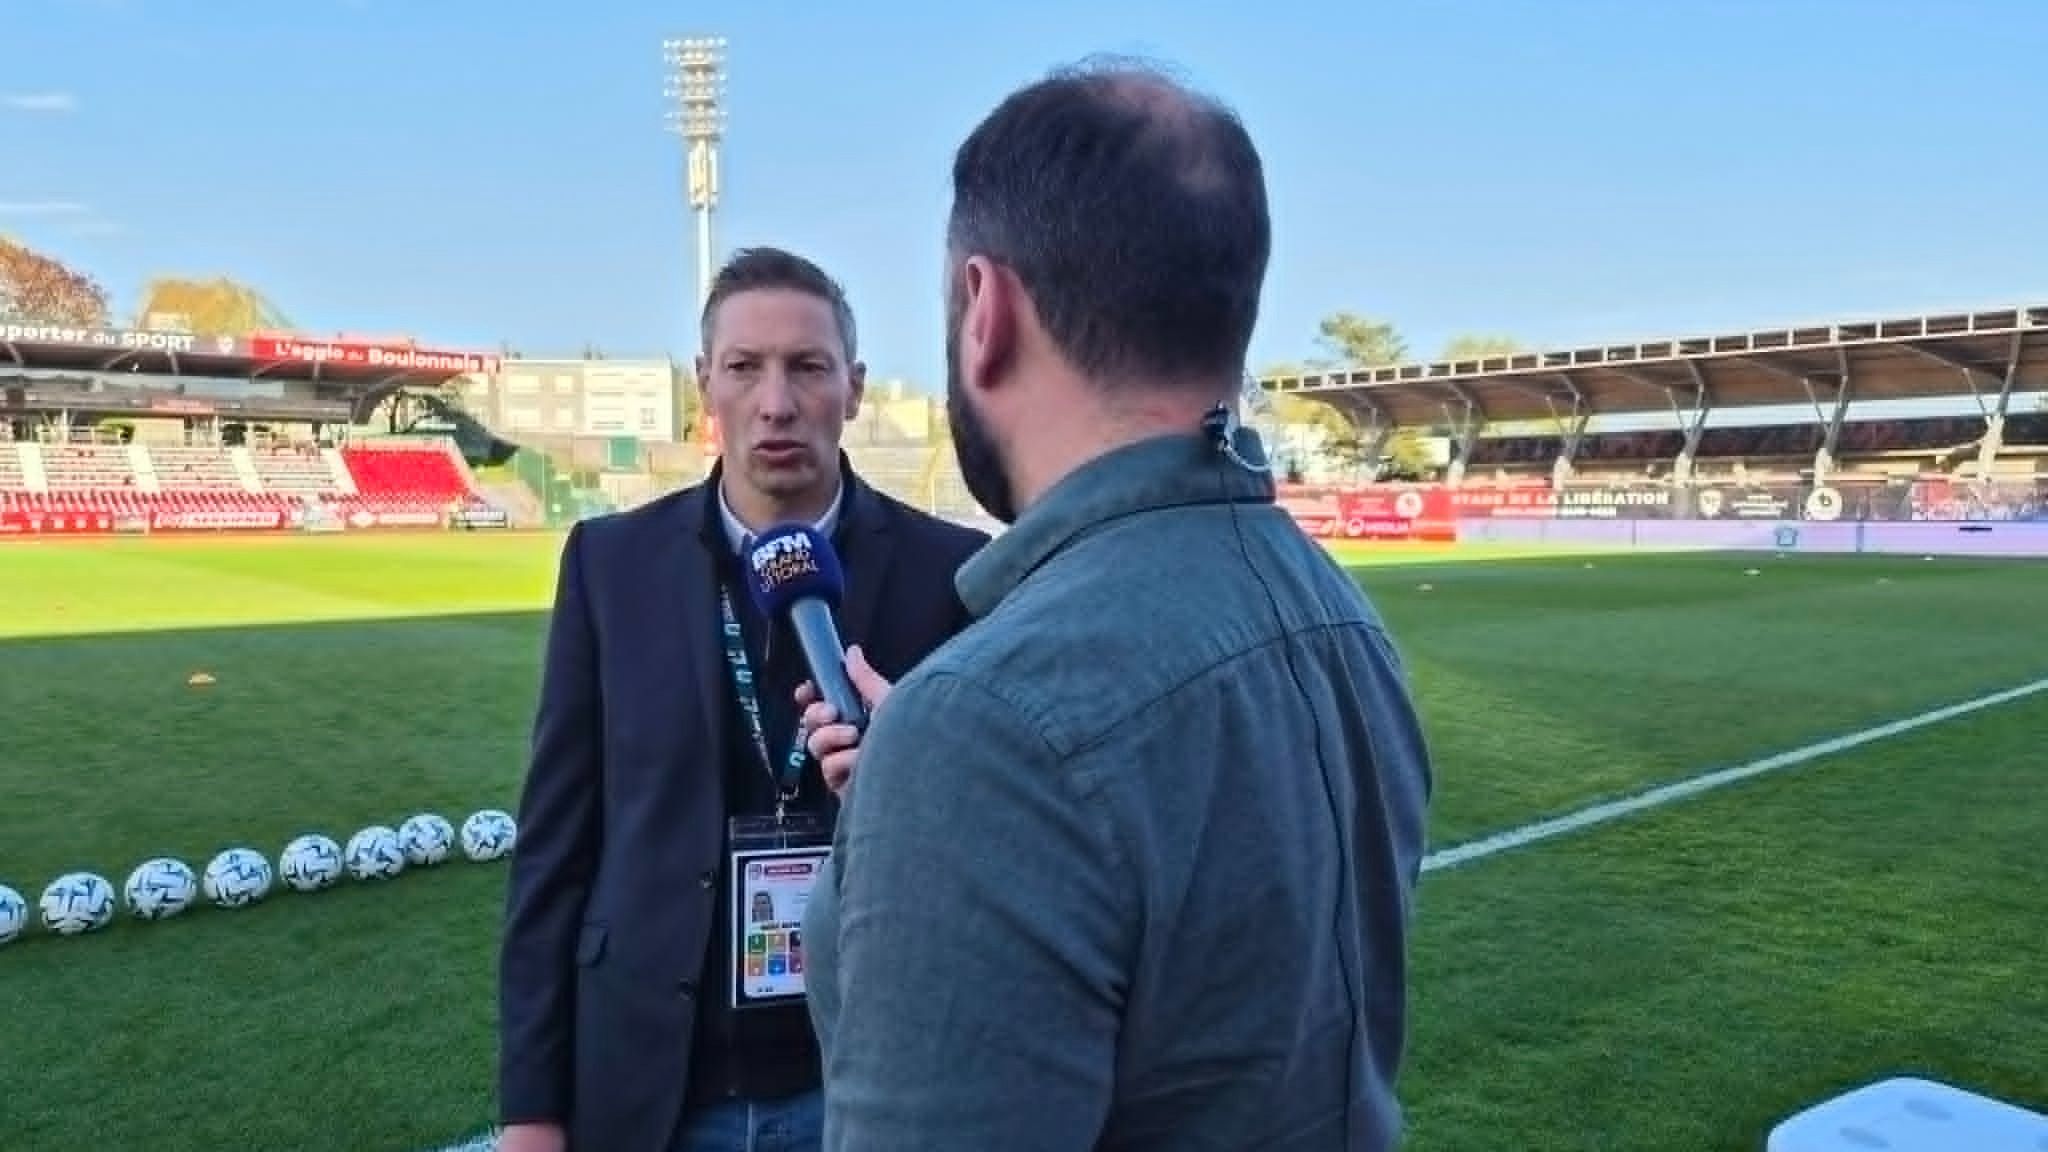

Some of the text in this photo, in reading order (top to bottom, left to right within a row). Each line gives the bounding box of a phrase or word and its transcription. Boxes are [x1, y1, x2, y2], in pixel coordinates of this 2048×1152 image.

[122, 332, 195, 351] SPORT
[368, 348, 480, 370] Boulonnais
[1451, 489, 1669, 504] STADE DE LA LIBÉRATION
[752, 532, 811, 571] BFM
